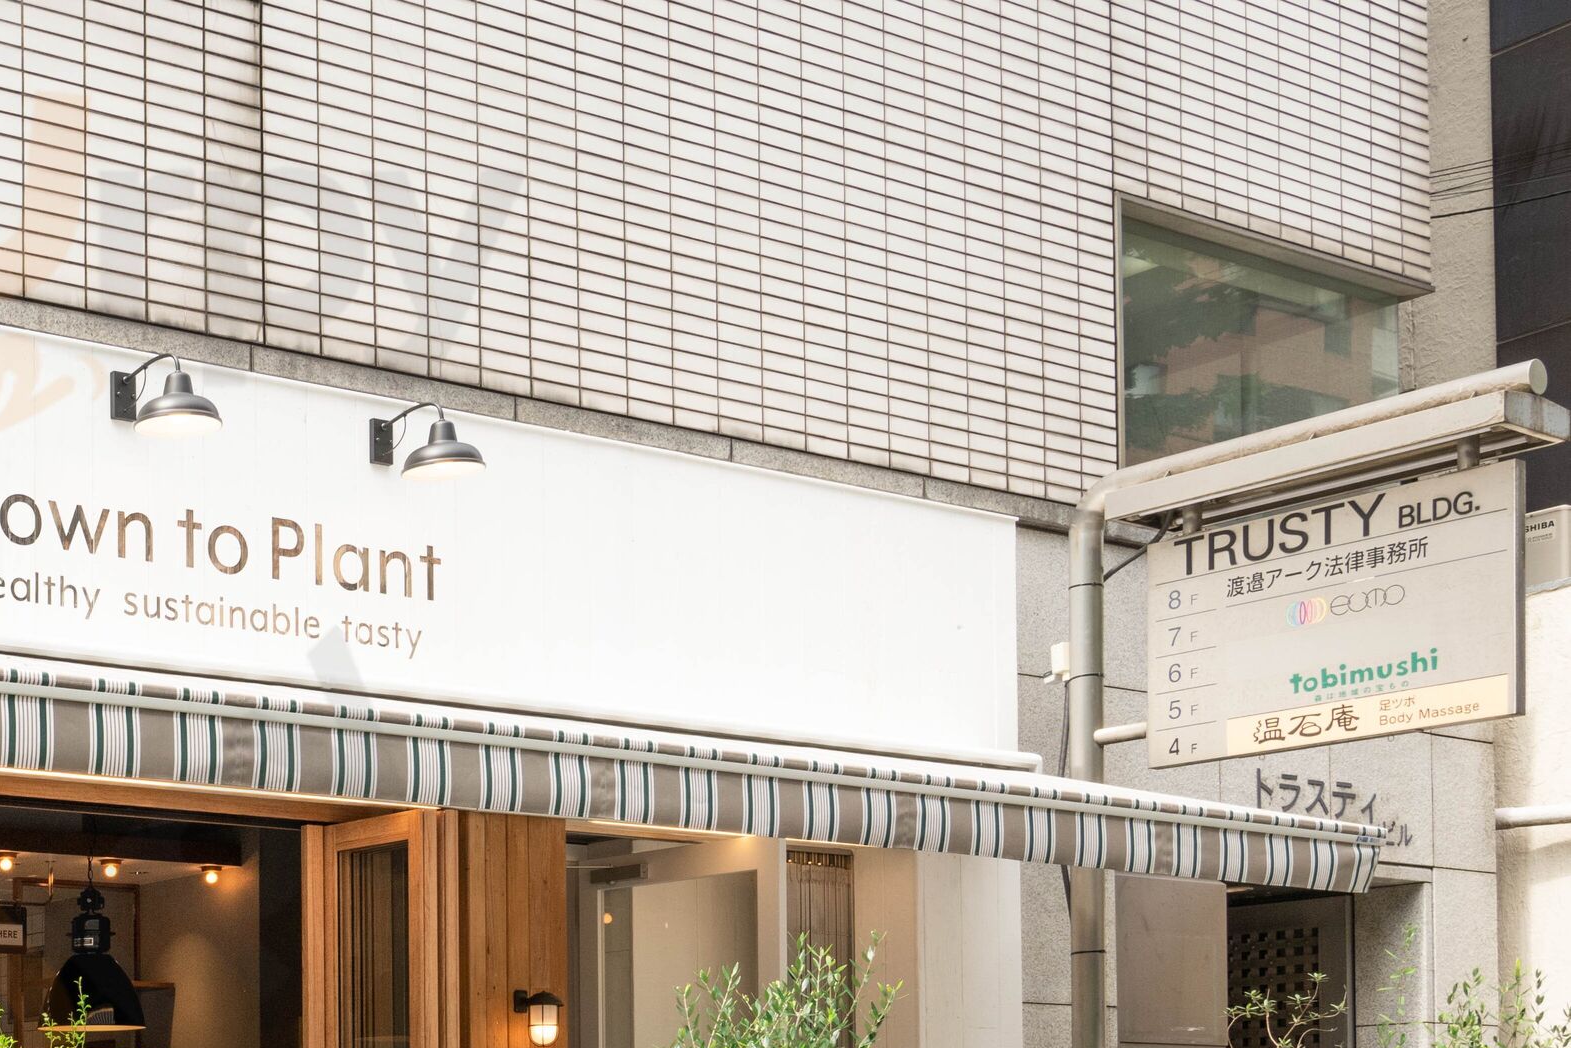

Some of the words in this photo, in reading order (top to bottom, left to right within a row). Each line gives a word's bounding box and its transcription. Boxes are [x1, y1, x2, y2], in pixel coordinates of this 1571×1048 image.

[1174, 493, 1386, 576] TRUSTY
[1398, 491, 1481, 529] BLDG.
[177, 508, 249, 576] to
[271, 516, 442, 602] Plant
[1168, 590, 1181, 610] 8
[1190, 593, 1199, 606] F
[123, 592, 320, 641] sustainable
[340, 614, 423, 660] tasty
[1168, 626, 1181, 647] 7
[1190, 630, 1199, 643] F
[1168, 663, 1181, 683] 6
[1190, 667, 1199, 680] F
[1289, 647, 1439, 694] tobimushi
[1168, 699, 1181, 720] 5
[1190, 704, 1199, 717] F
[1379, 711, 1414, 726] Body
[1418, 701, 1481, 719] Massage
[1168, 737, 1180, 756] 4
[1190, 742, 1198, 755] F
